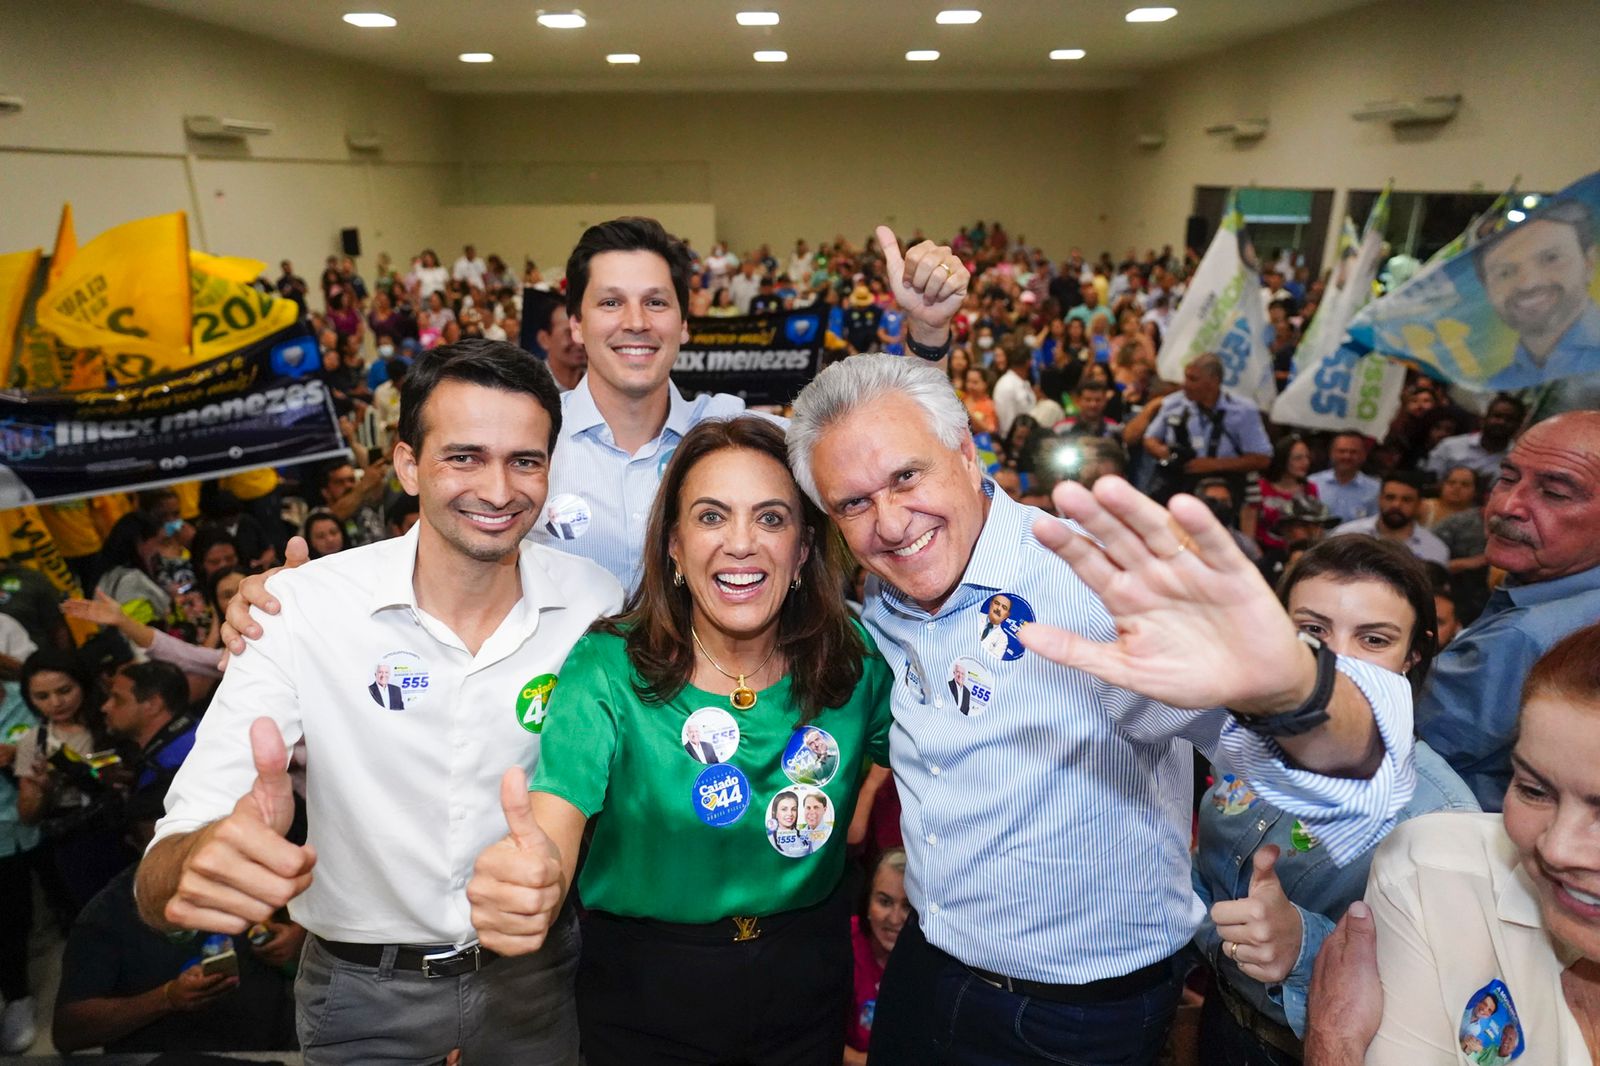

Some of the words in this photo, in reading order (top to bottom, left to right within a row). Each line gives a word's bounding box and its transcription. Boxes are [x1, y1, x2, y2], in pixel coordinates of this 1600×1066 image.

[672, 350, 704, 371] ax
[706, 349, 811, 372] menezes
[161, 379, 325, 432] menezes
[401, 676, 430, 689] 555
[971, 684, 992, 702] 555
[523, 689, 553, 725] 4
[699, 775, 739, 796] Caiado
[717, 784, 743, 808] 44
